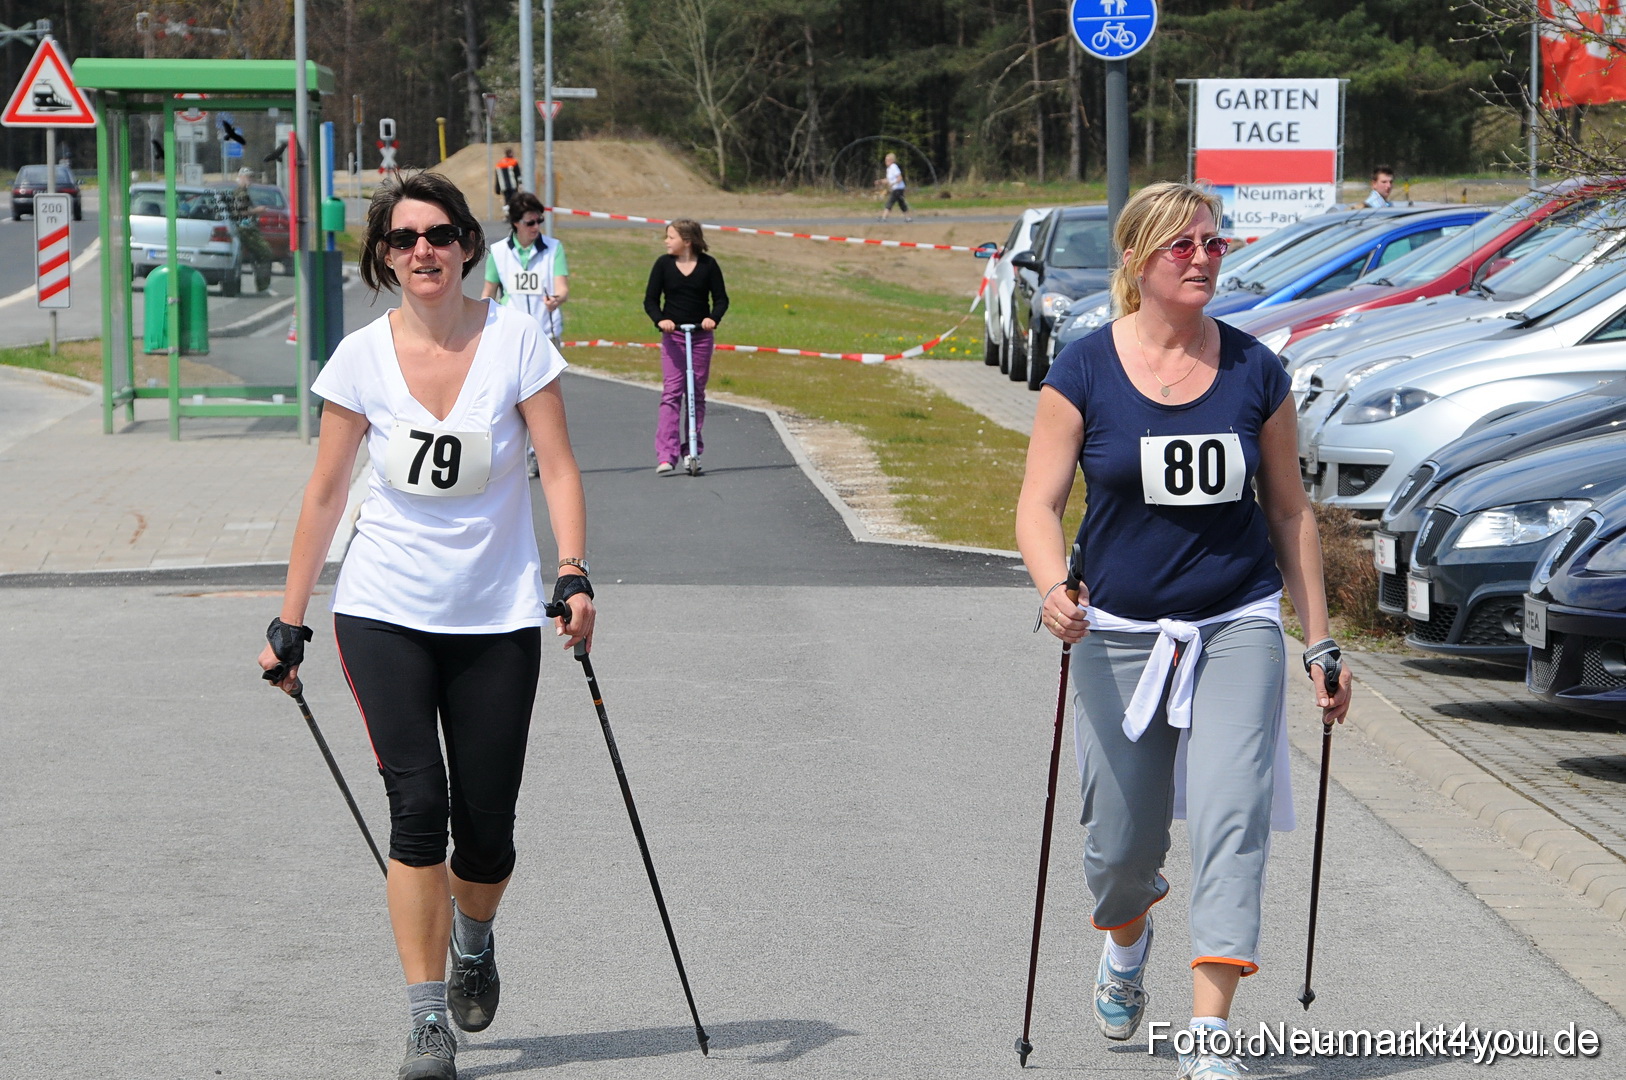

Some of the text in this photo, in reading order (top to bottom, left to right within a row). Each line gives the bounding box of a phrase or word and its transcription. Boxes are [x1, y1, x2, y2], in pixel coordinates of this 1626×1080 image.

[1215, 87, 1319, 110] GARTEN
[1232, 121, 1301, 143] TAGE
[1237, 186, 1325, 201] Neumarkt
[41, 202, 62, 214] 200
[46, 215, 57, 224] m
[514, 272, 539, 291] 120
[407, 428, 462, 490] 79
[1163, 438, 1226, 496] 80
